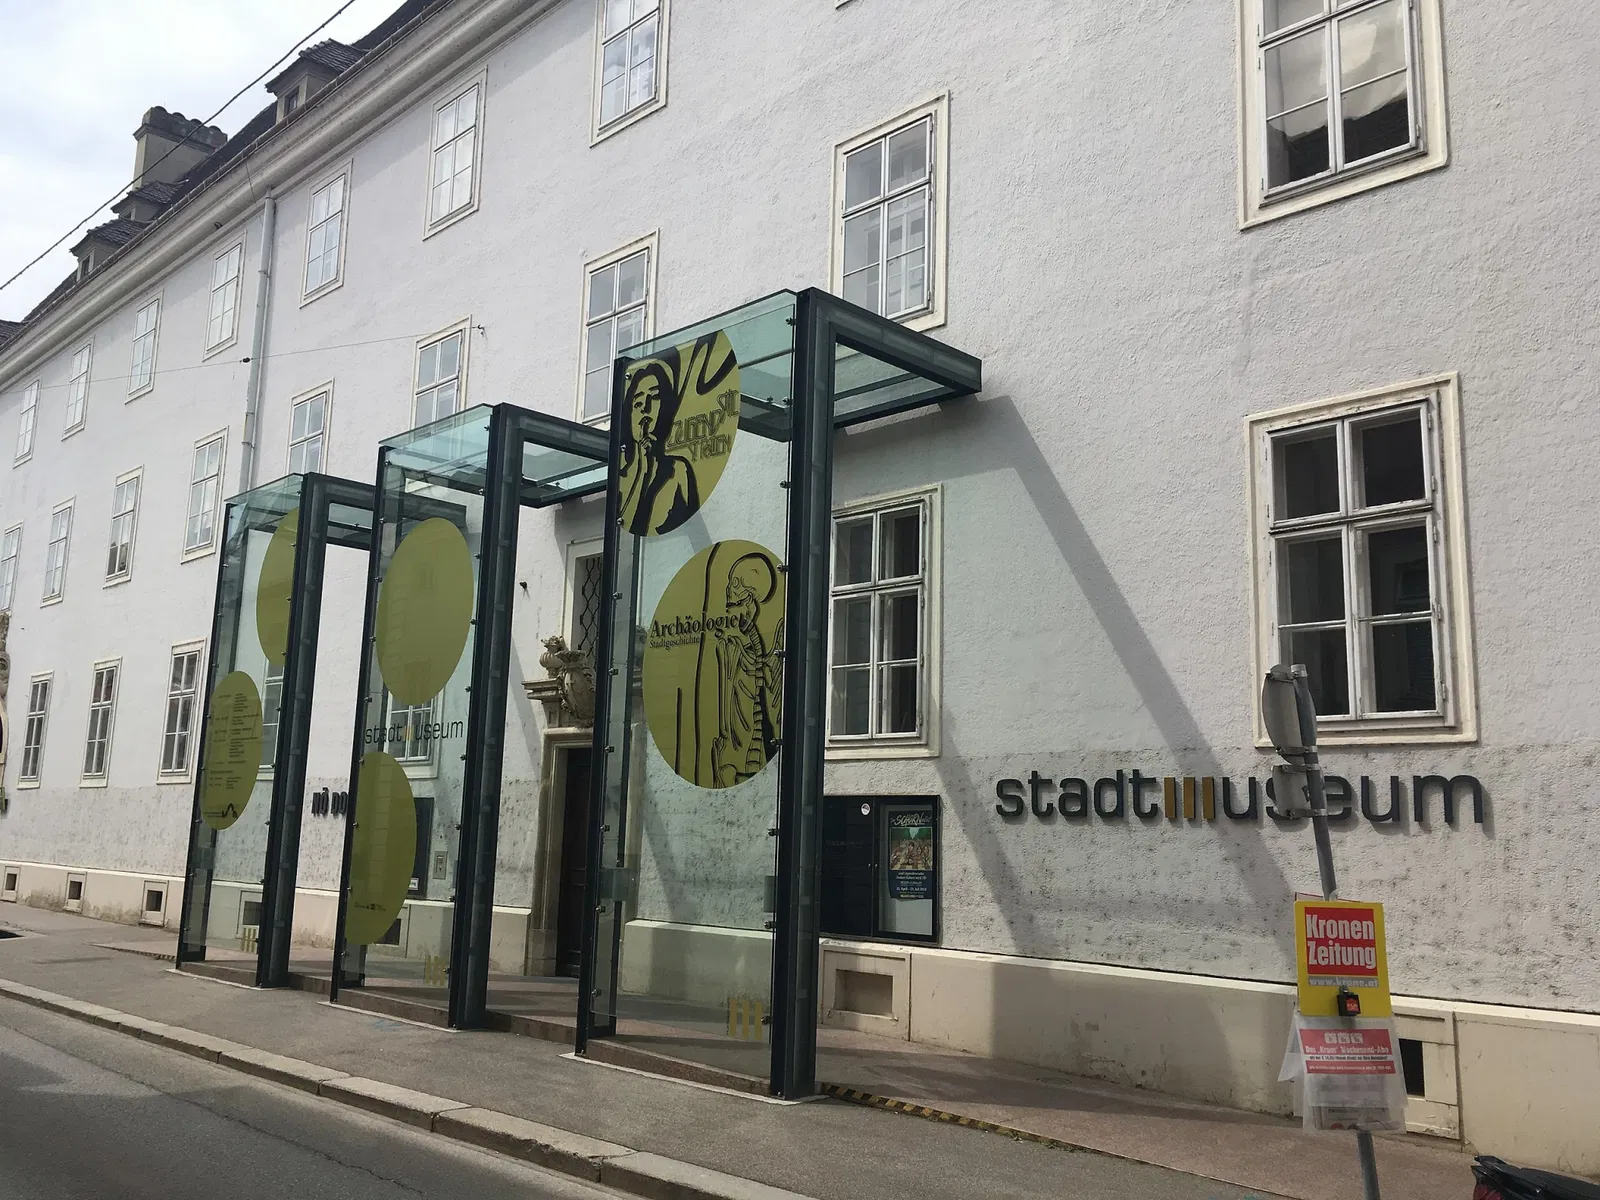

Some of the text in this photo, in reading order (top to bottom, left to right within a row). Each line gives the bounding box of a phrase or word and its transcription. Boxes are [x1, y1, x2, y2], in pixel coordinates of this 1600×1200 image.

[650, 608, 740, 639] Archäologie
[1306, 914, 1375, 940] Kronen
[1308, 940, 1376, 970] Zeitung
